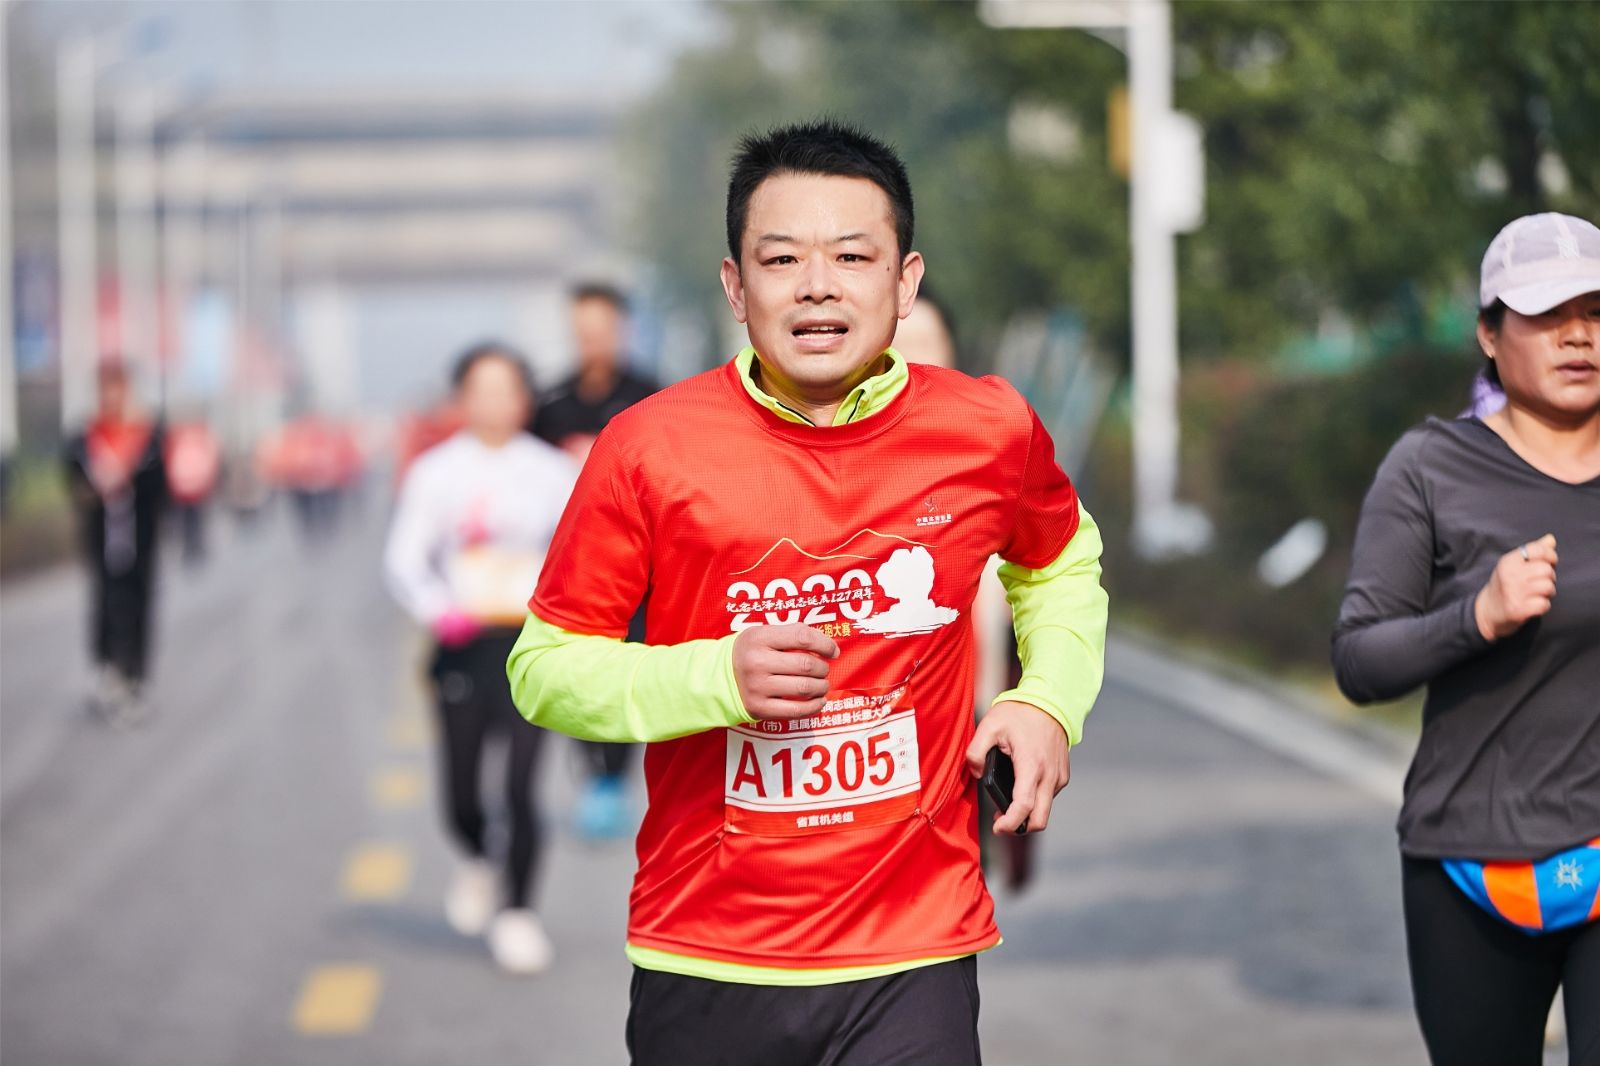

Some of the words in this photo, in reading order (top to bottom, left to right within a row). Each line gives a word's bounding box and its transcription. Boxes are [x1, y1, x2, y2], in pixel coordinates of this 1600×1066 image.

[726, 569, 875, 633] 2020
[810, 622, 851, 637] 长跑大赛
[732, 731, 896, 799] A1305
[796, 811, 855, 828] 省直机关组
